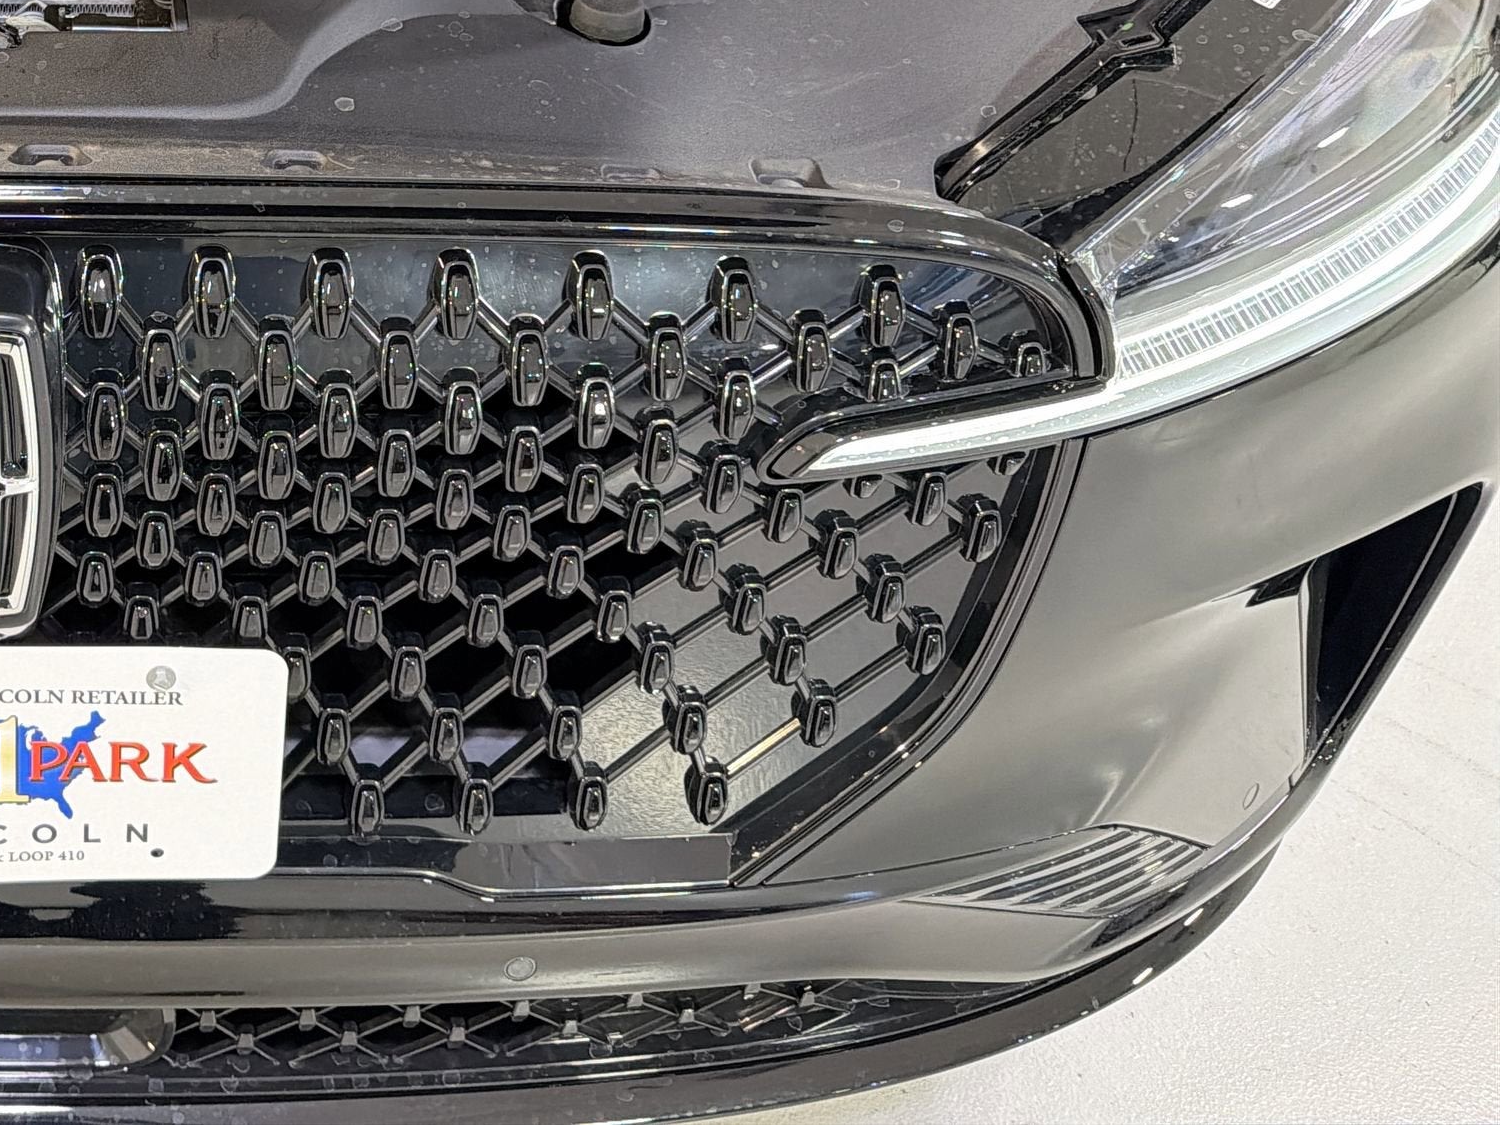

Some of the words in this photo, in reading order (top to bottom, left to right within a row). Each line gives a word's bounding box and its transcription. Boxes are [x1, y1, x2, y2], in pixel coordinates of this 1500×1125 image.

[72, 689, 183, 705] RETAILER
[29, 740, 218, 784] PARK
[9, 850, 54, 862] LOOP
[58, 850, 85, 861] 410
